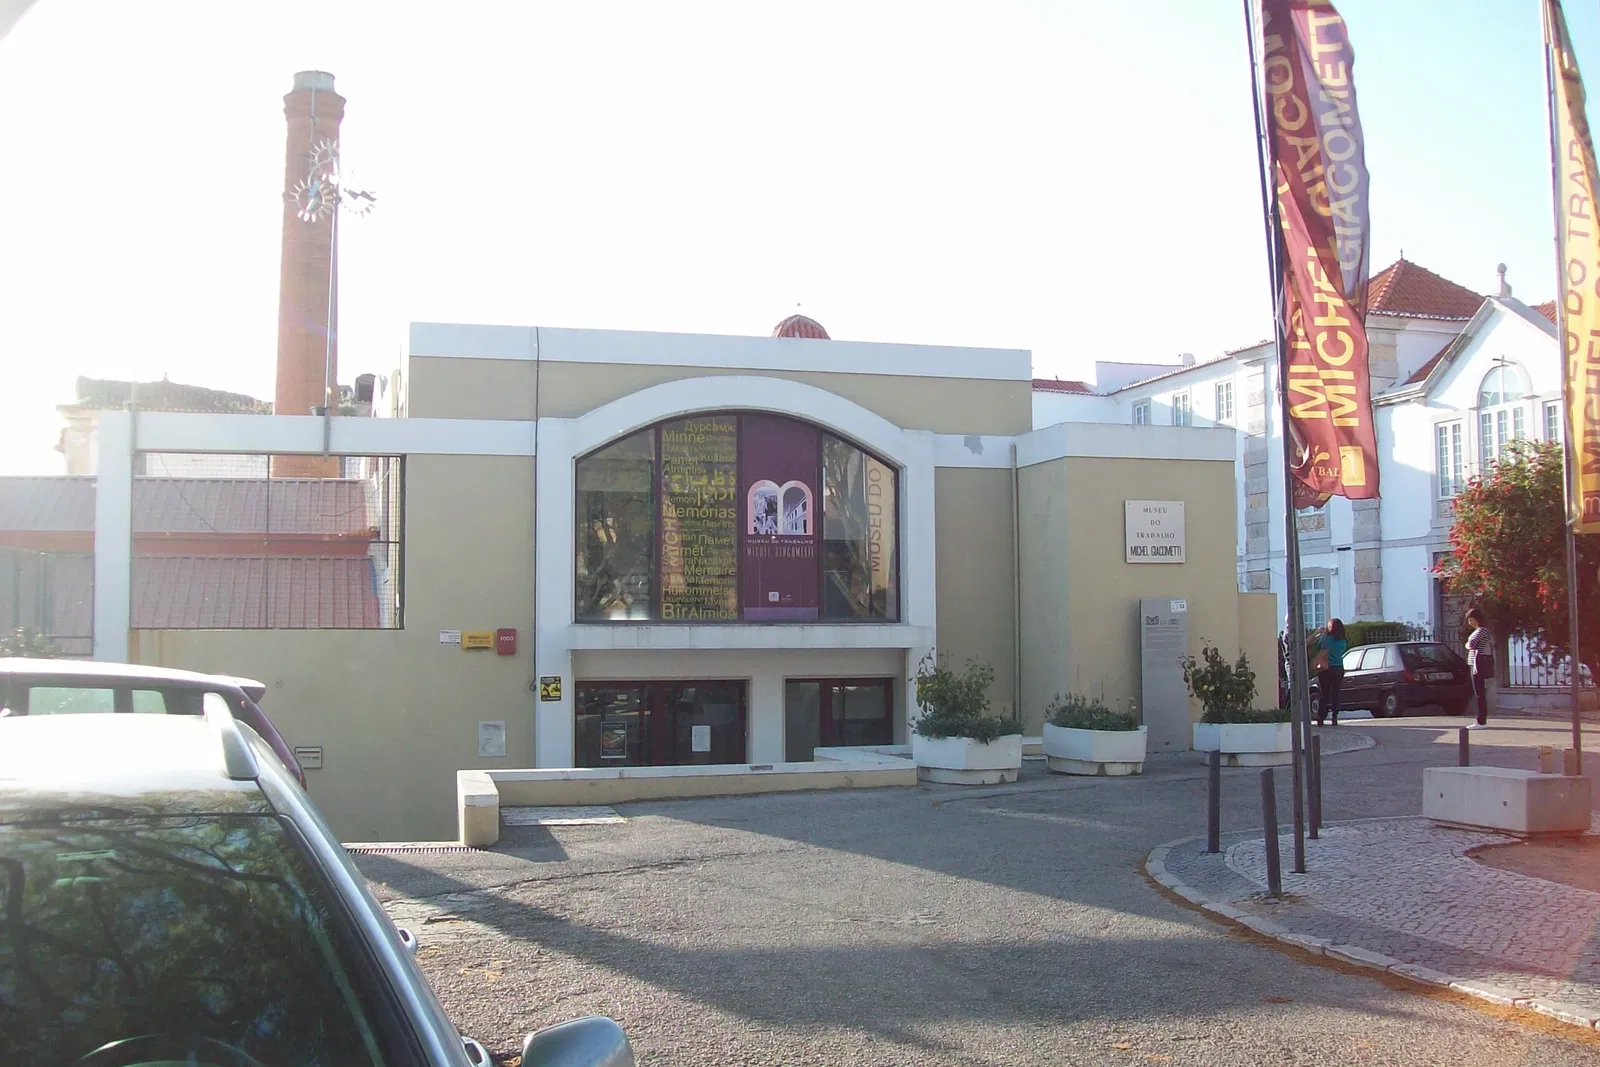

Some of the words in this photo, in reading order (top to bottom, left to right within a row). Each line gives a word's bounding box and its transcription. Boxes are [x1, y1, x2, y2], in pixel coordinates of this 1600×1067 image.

[867, 468, 883, 497] DO
[1130, 545, 1149, 557] MICHEL
[1151, 545, 1182, 557] GIACOMETTI
